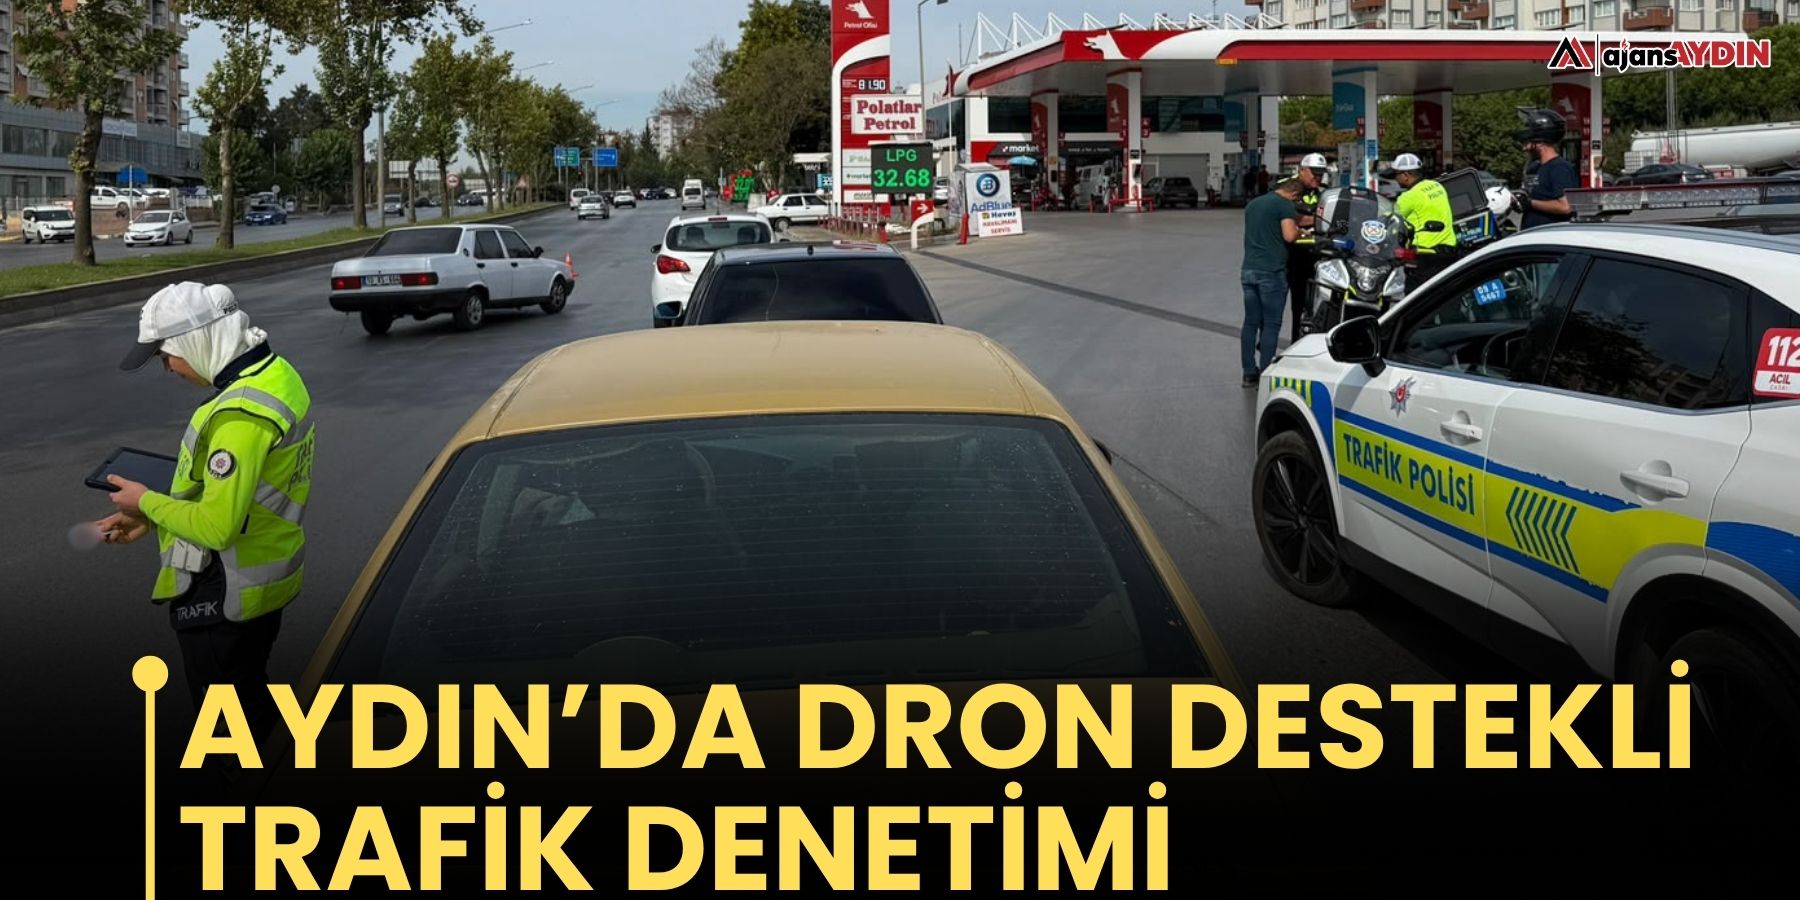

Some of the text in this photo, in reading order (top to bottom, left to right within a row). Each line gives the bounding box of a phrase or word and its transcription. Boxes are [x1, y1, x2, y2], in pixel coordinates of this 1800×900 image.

[856, 99, 922, 114] Polatlar
[864, 117, 916, 130] Petrol
[886, 149, 917, 162] LPG
[1009, 144, 1040, 153] market
[873, 168, 930, 188] 32.68
[1767, 335, 1800, 368] 112
[1343, 433, 1475, 516] TRAFİK POLİSİ
